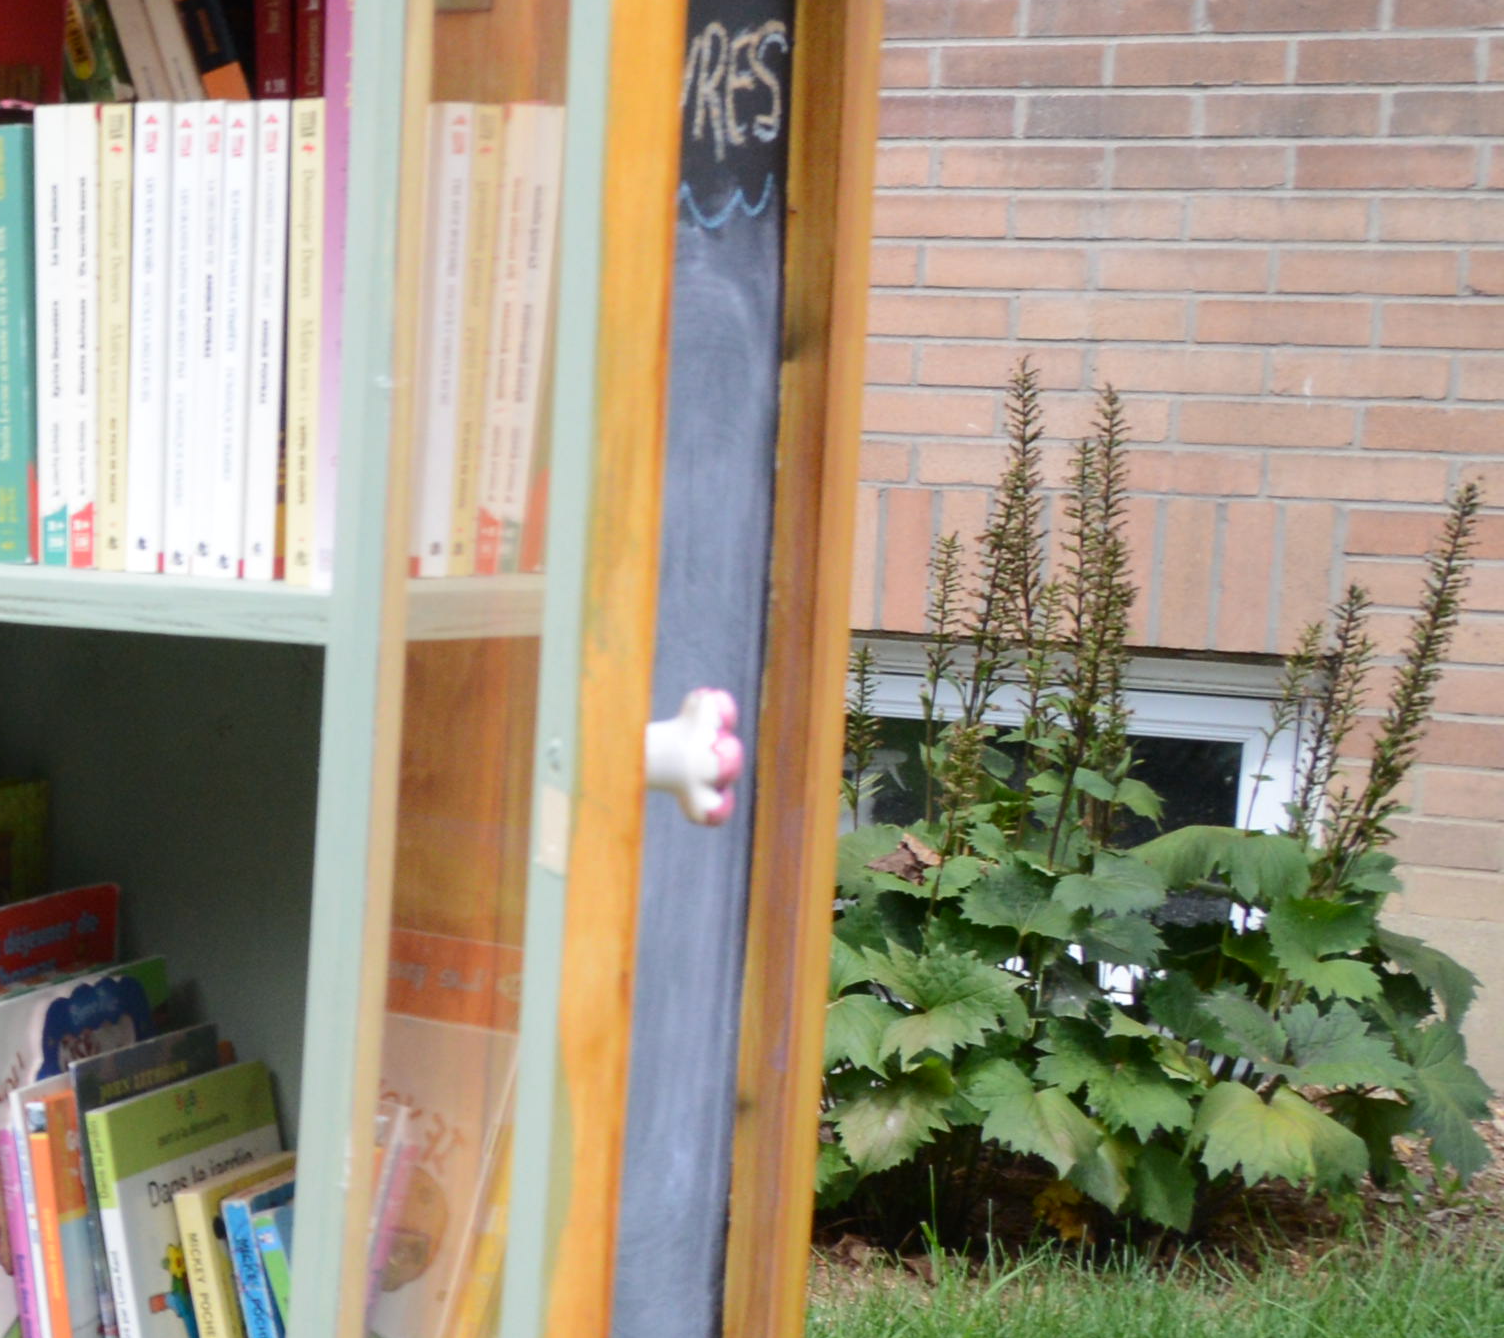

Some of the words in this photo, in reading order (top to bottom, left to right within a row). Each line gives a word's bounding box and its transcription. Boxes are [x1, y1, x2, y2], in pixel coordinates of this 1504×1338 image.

[3, 919, 72, 961] déjeuner
[76, 910, 99, 935] de
[185, 1230, 207, 1285] MICKEY
[196, 1290, 217, 1338] POCHE
